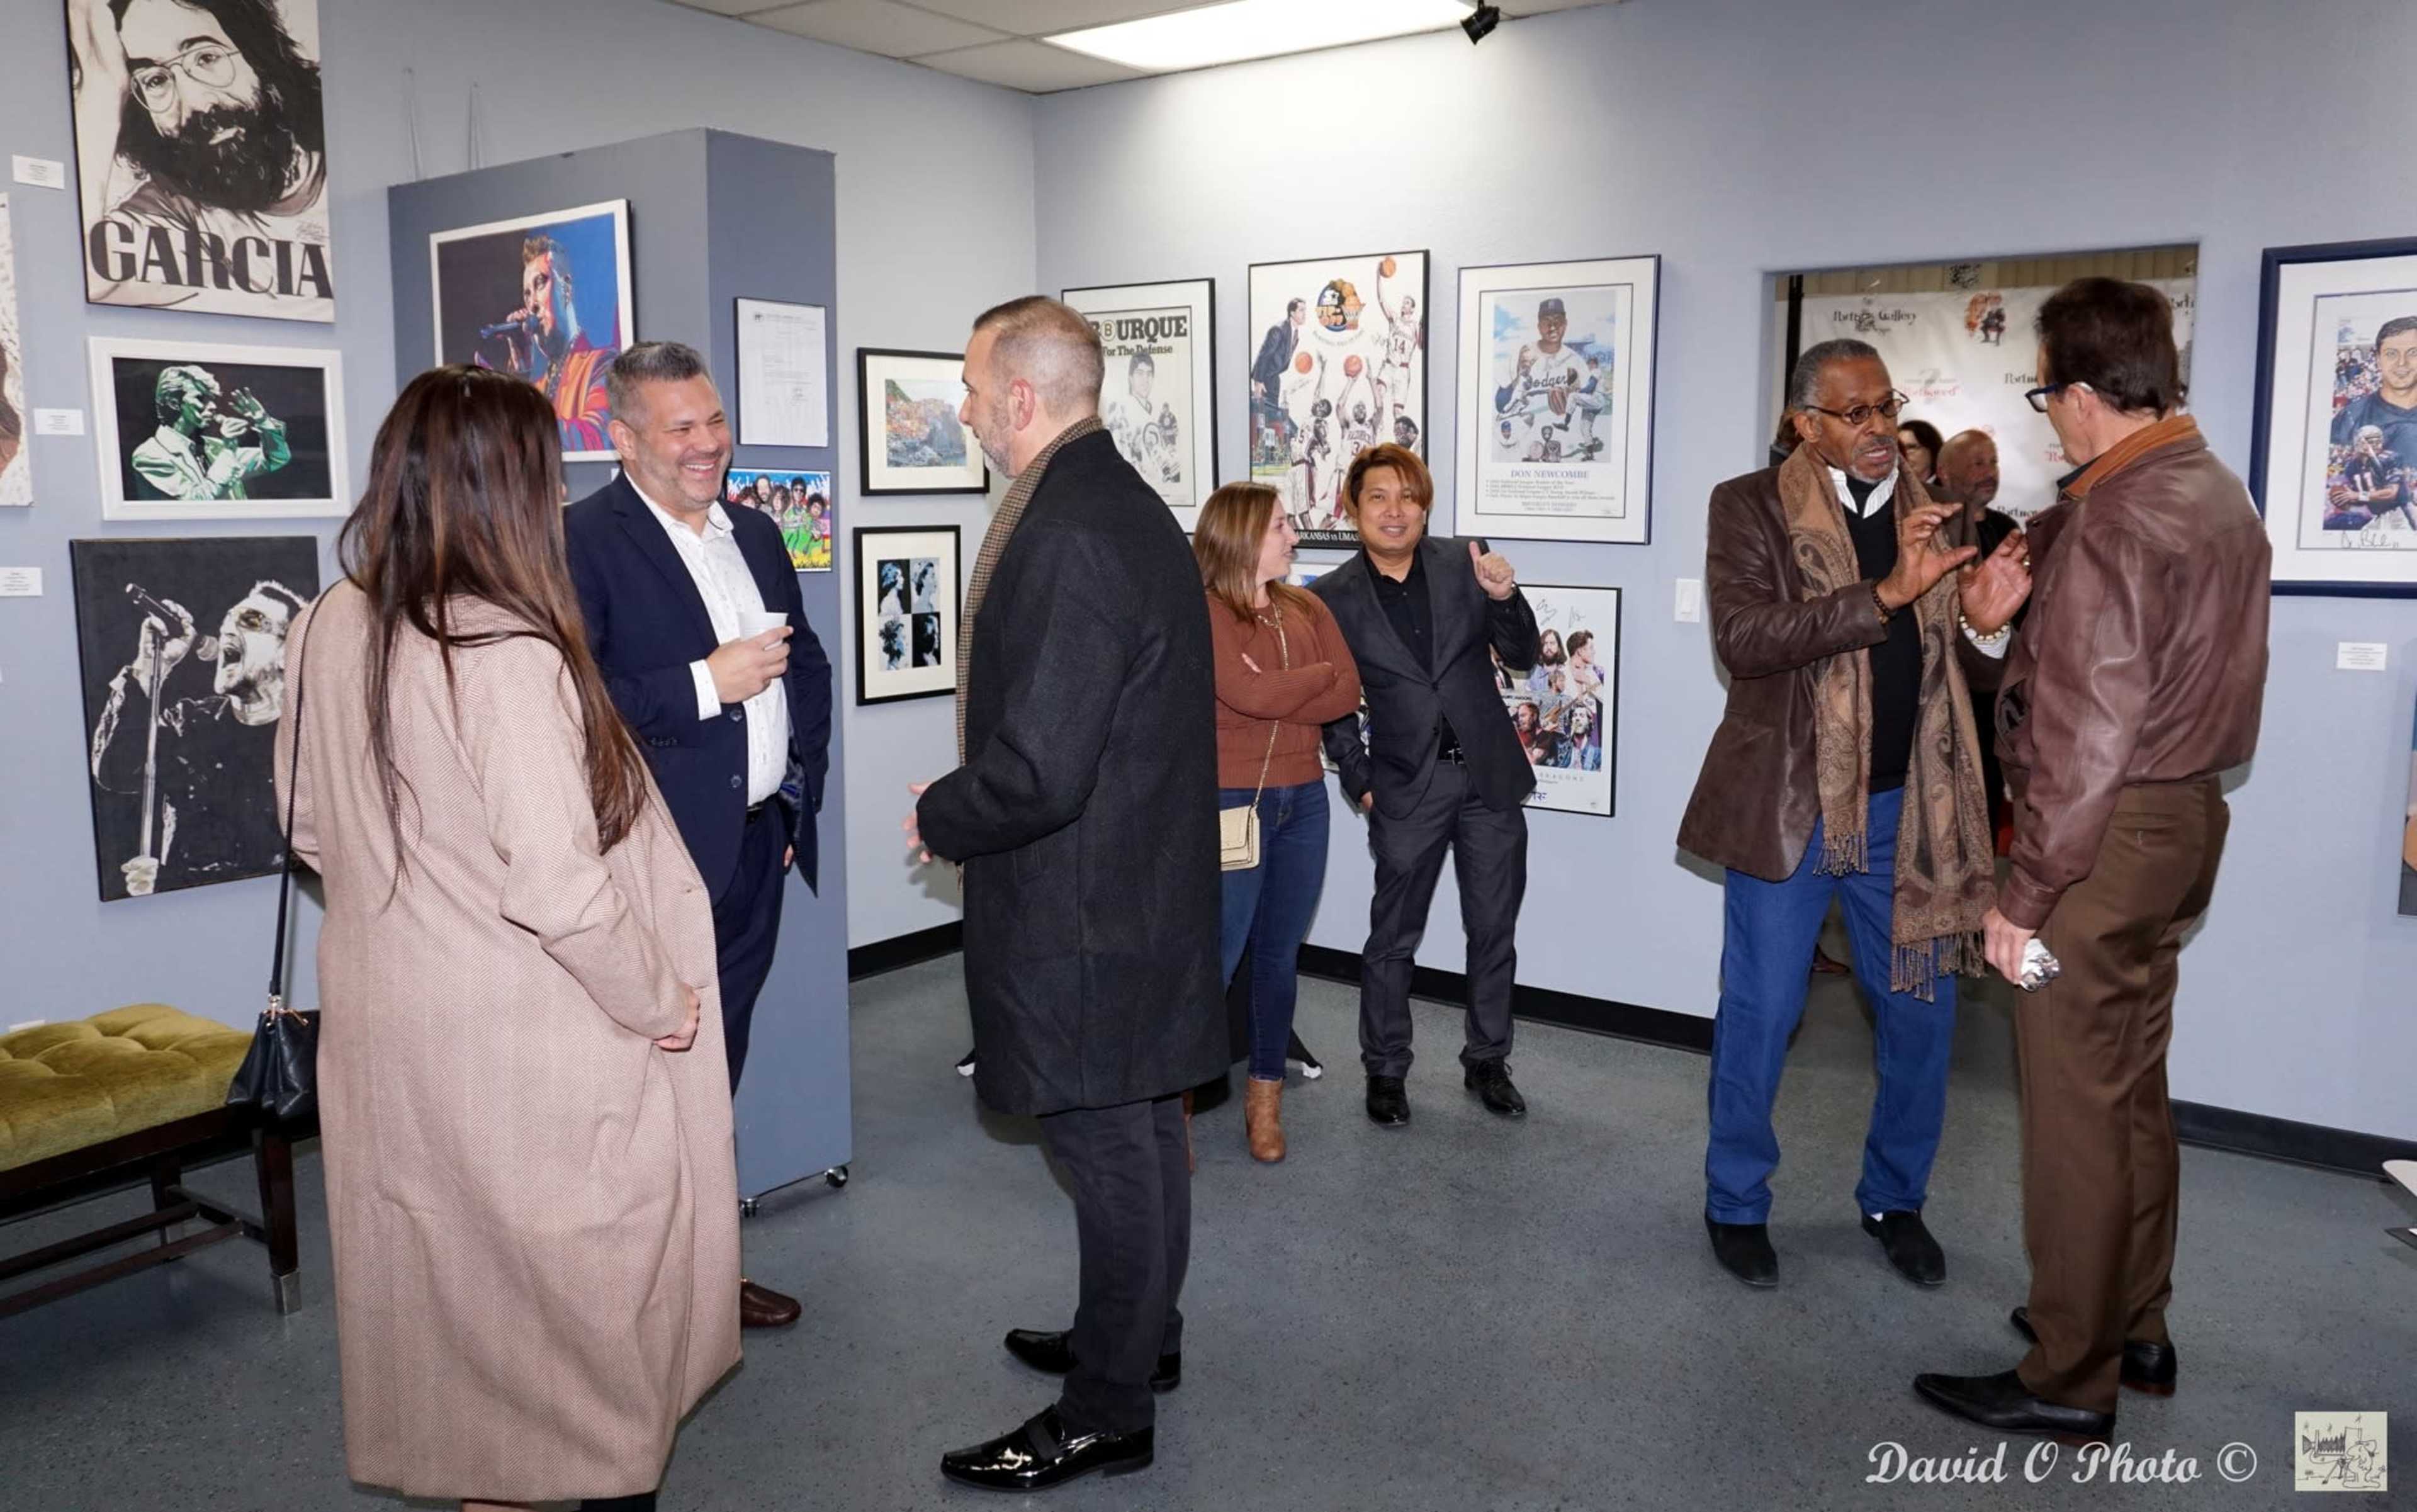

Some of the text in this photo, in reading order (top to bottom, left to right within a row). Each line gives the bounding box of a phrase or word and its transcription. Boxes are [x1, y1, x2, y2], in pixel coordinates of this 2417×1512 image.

[90, 220, 334, 299] GARCIA
[1878, 310, 1917, 325] Gallery
[1117, 345, 1134, 355] The
[1136, 344, 1173, 354] Defense
[1394, 339, 1406, 354] 14
[1511, 470, 1587, 479] DON NEWCOMBE
[2354, 472, 2375, 492] 11
